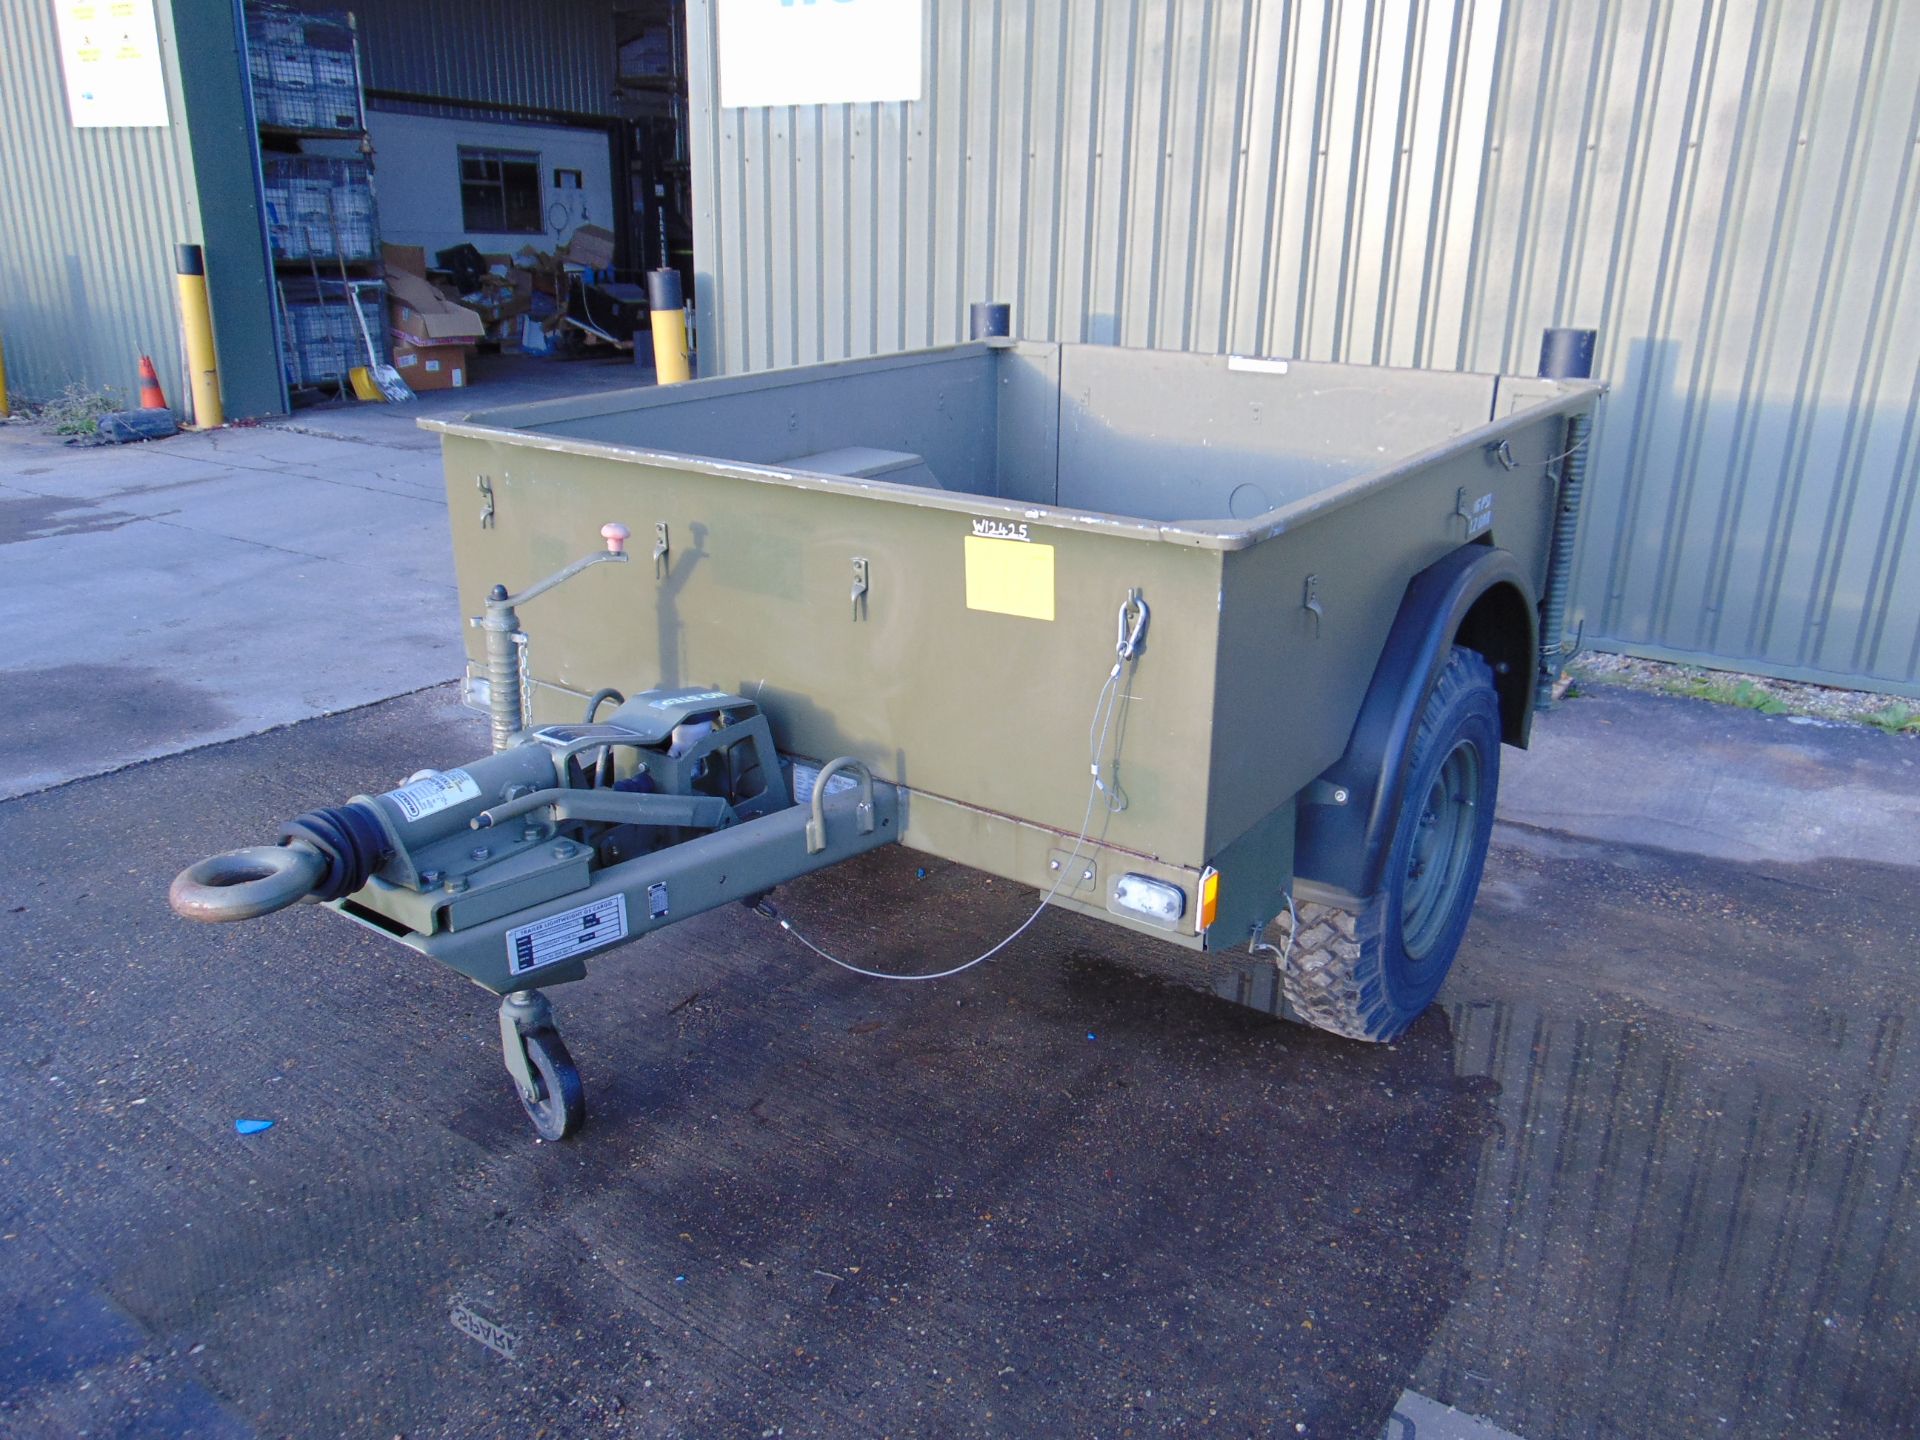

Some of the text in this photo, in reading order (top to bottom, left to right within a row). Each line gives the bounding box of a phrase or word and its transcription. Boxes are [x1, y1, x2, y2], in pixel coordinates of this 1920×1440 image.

[520, 924, 543, 936] TRAILER
[544, 911, 583, 928] LIGHTWEIGHT
[592, 901, 613, 911] CARGO
